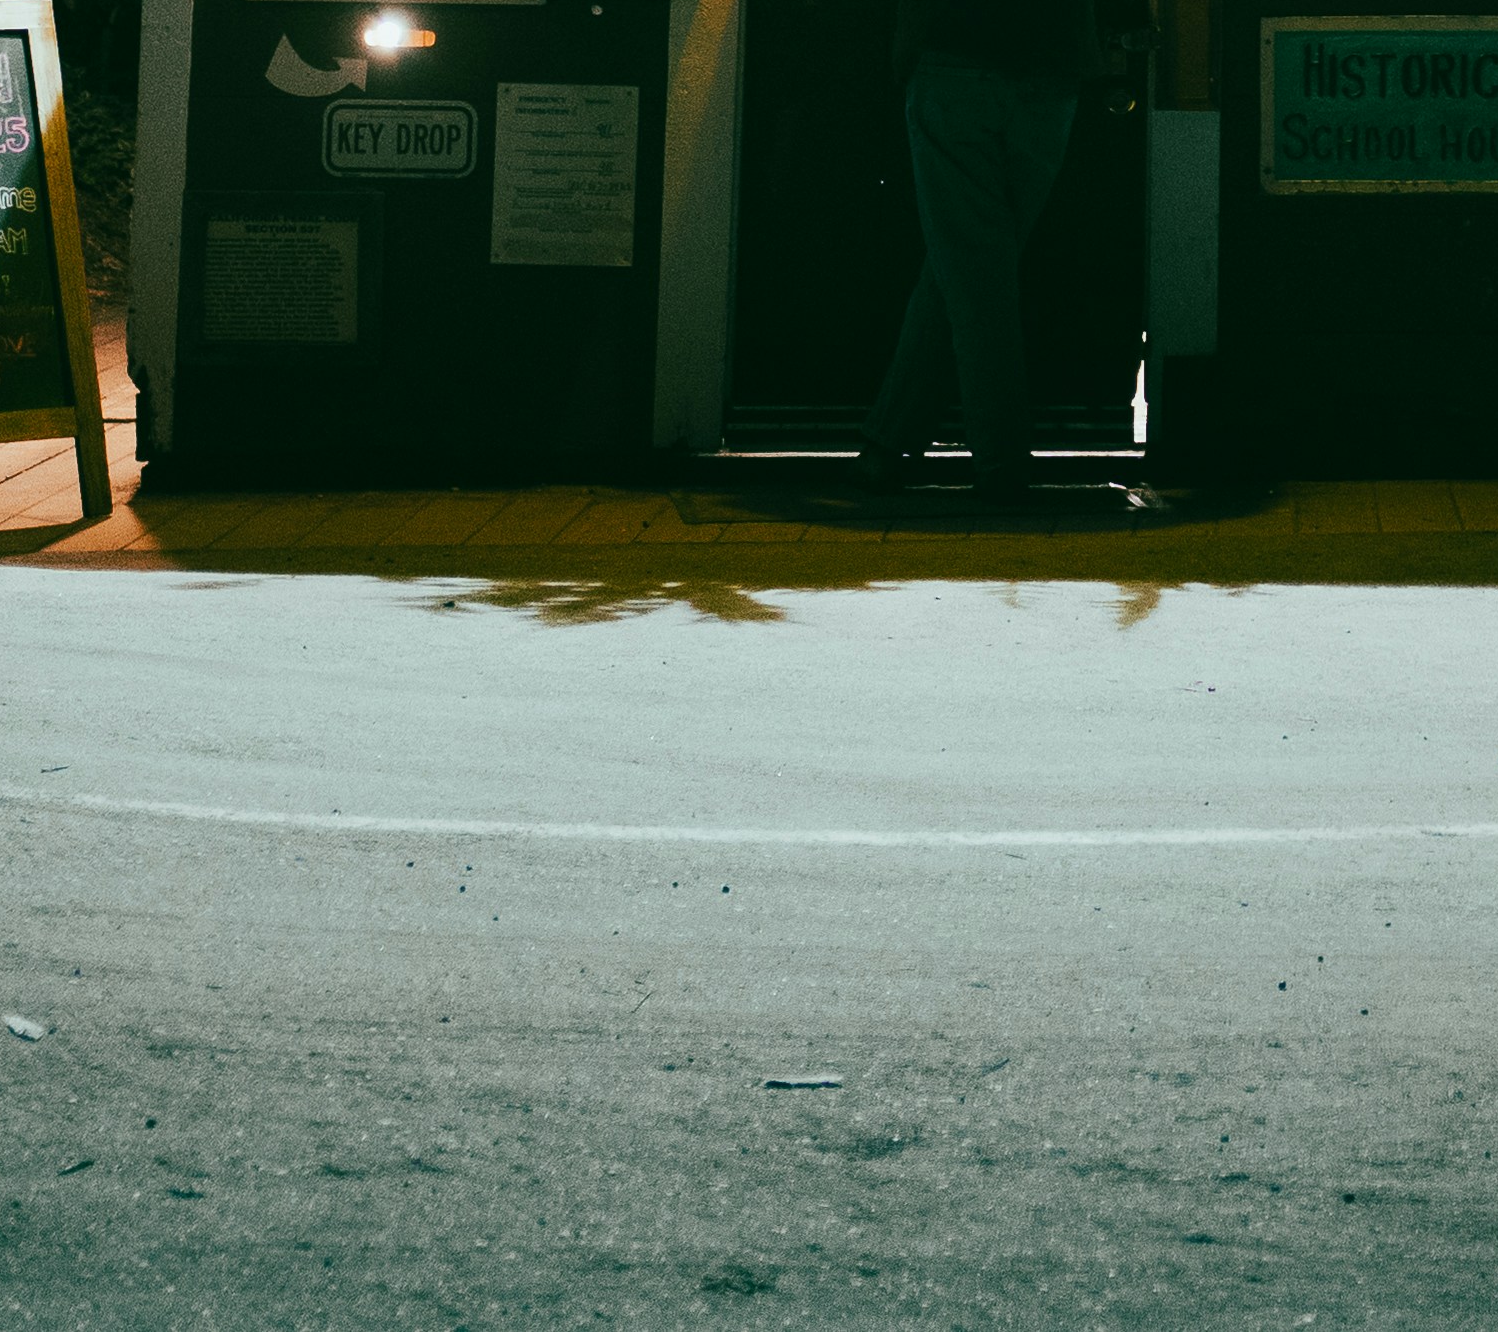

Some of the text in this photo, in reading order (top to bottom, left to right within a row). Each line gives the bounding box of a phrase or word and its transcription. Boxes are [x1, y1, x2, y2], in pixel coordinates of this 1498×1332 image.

[338, 122, 461, 156] KEY DROP
[1282, 111, 1428, 163] SCHOOL
